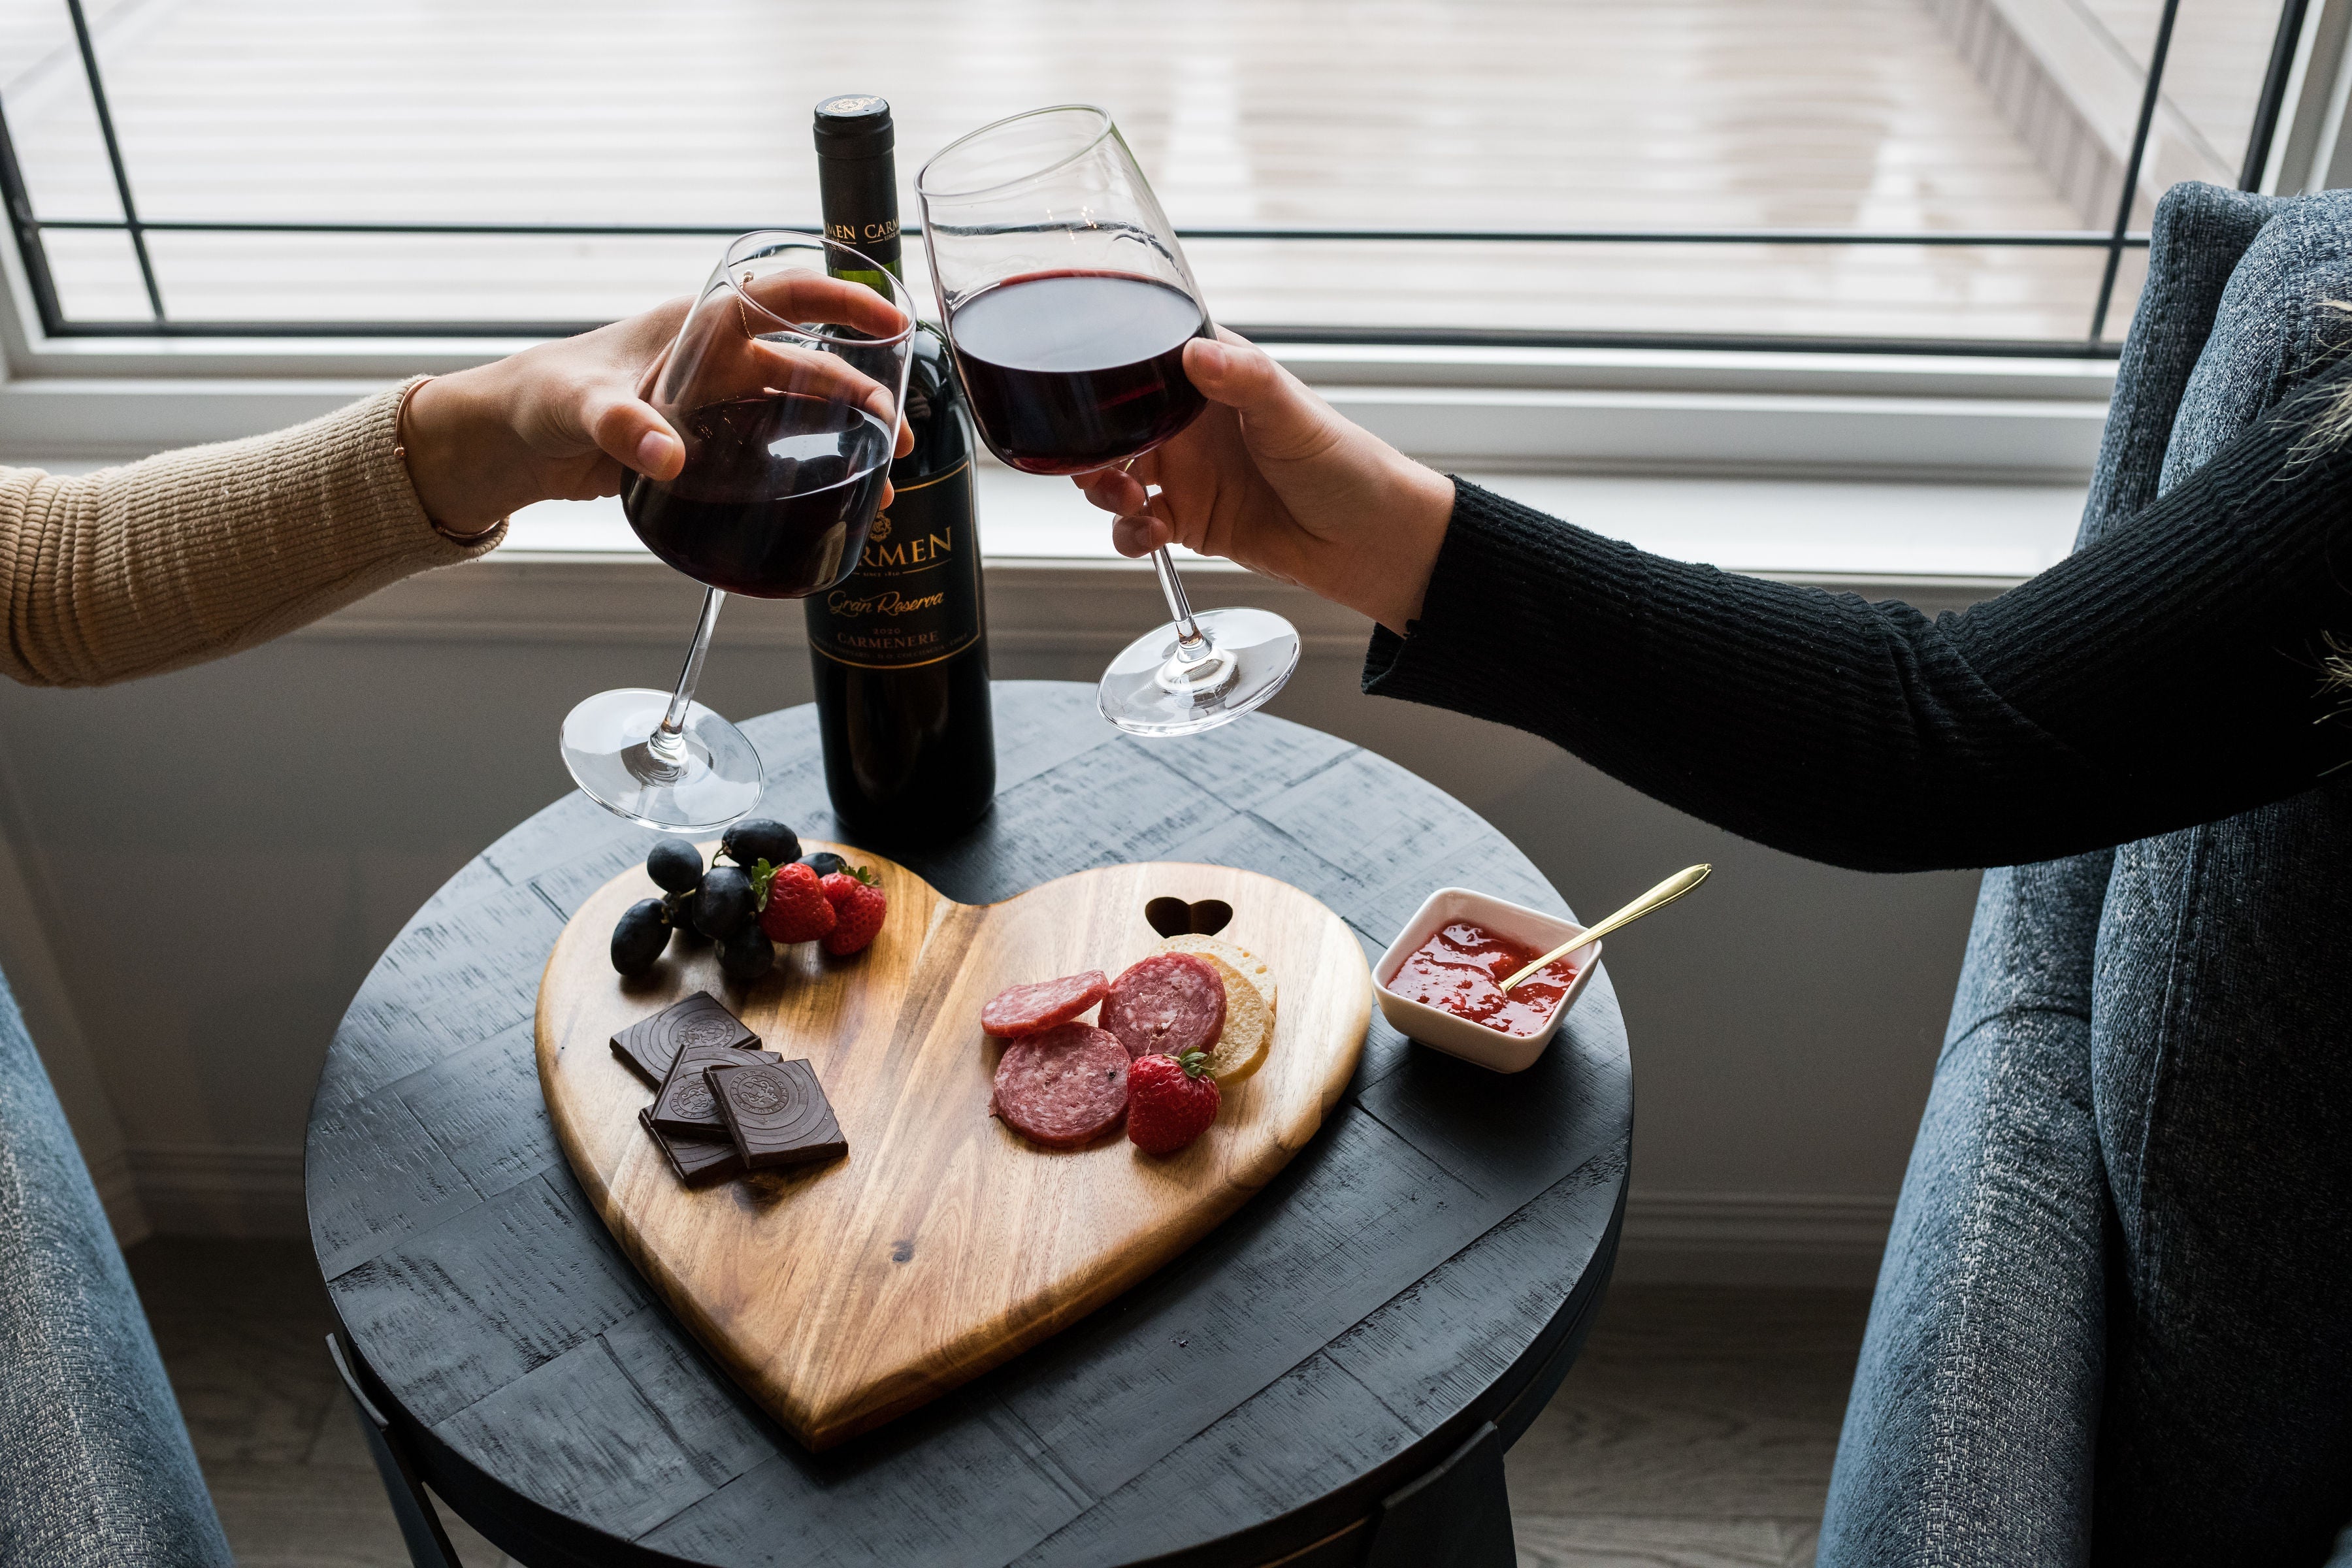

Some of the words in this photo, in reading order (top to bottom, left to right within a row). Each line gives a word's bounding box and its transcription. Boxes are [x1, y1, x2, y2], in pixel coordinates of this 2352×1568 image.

[857, 526, 951, 567] RMEN
[828, 590, 873, 617] Gran
[874, 591, 944, 616] Reserva
[837, 630, 939, 649] CARMENERE
